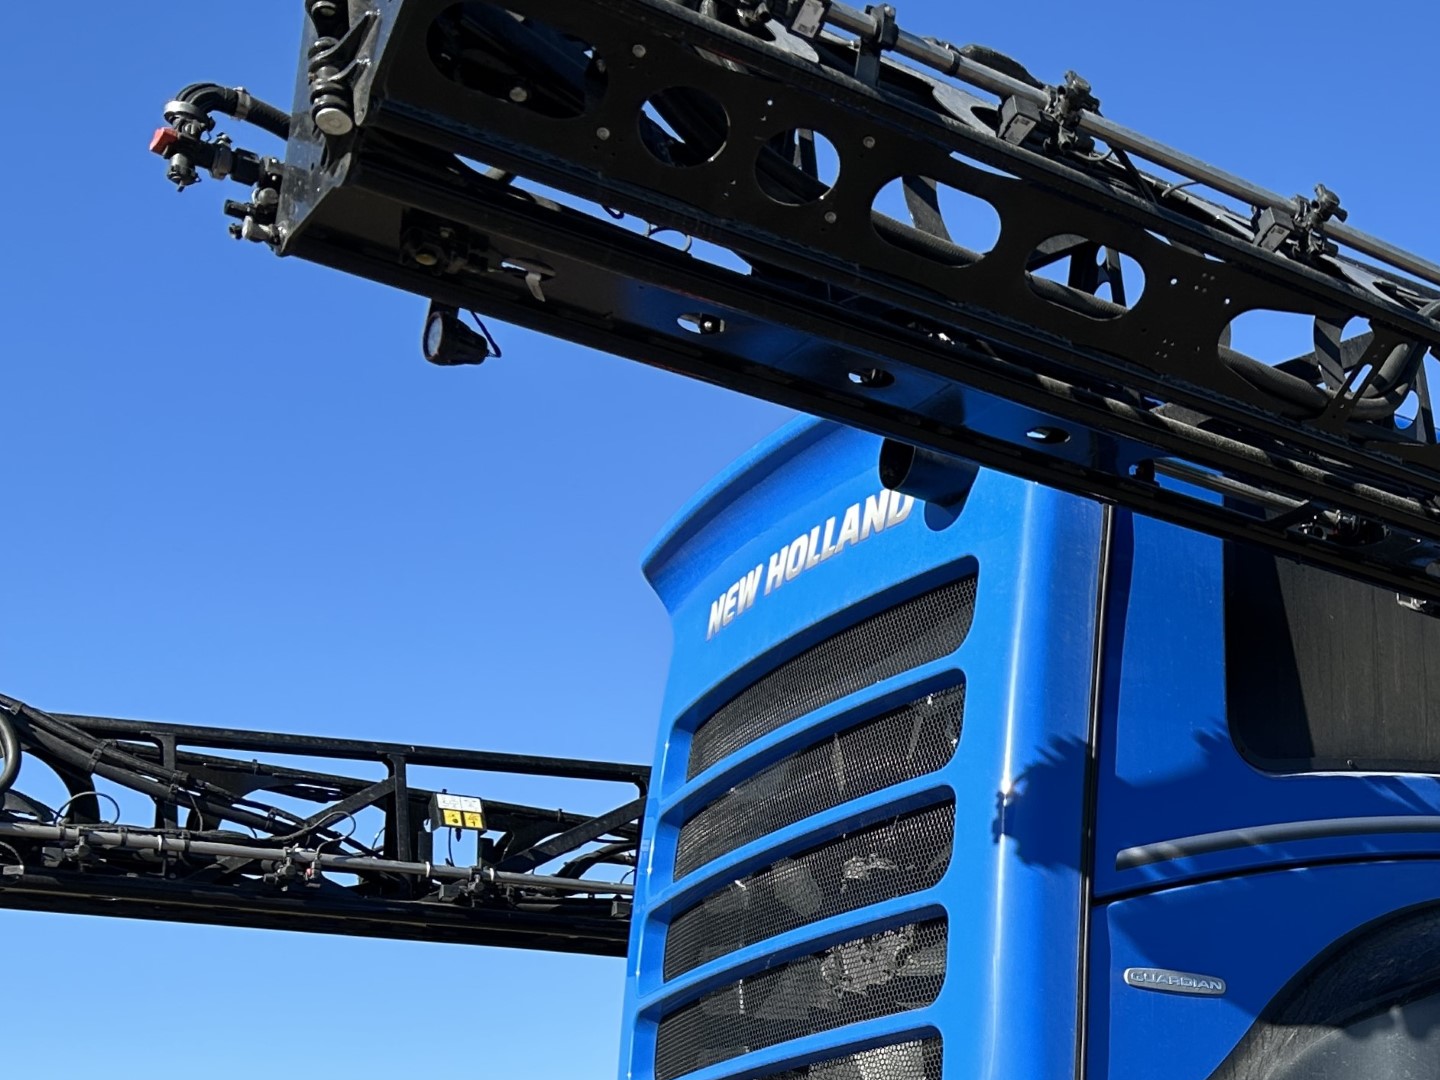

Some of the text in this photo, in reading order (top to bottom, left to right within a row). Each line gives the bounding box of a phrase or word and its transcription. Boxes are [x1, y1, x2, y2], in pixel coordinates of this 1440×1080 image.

[706, 488, 915, 641] NEW HOLLAND
[1130, 971, 1222, 990] GUARDIAN
